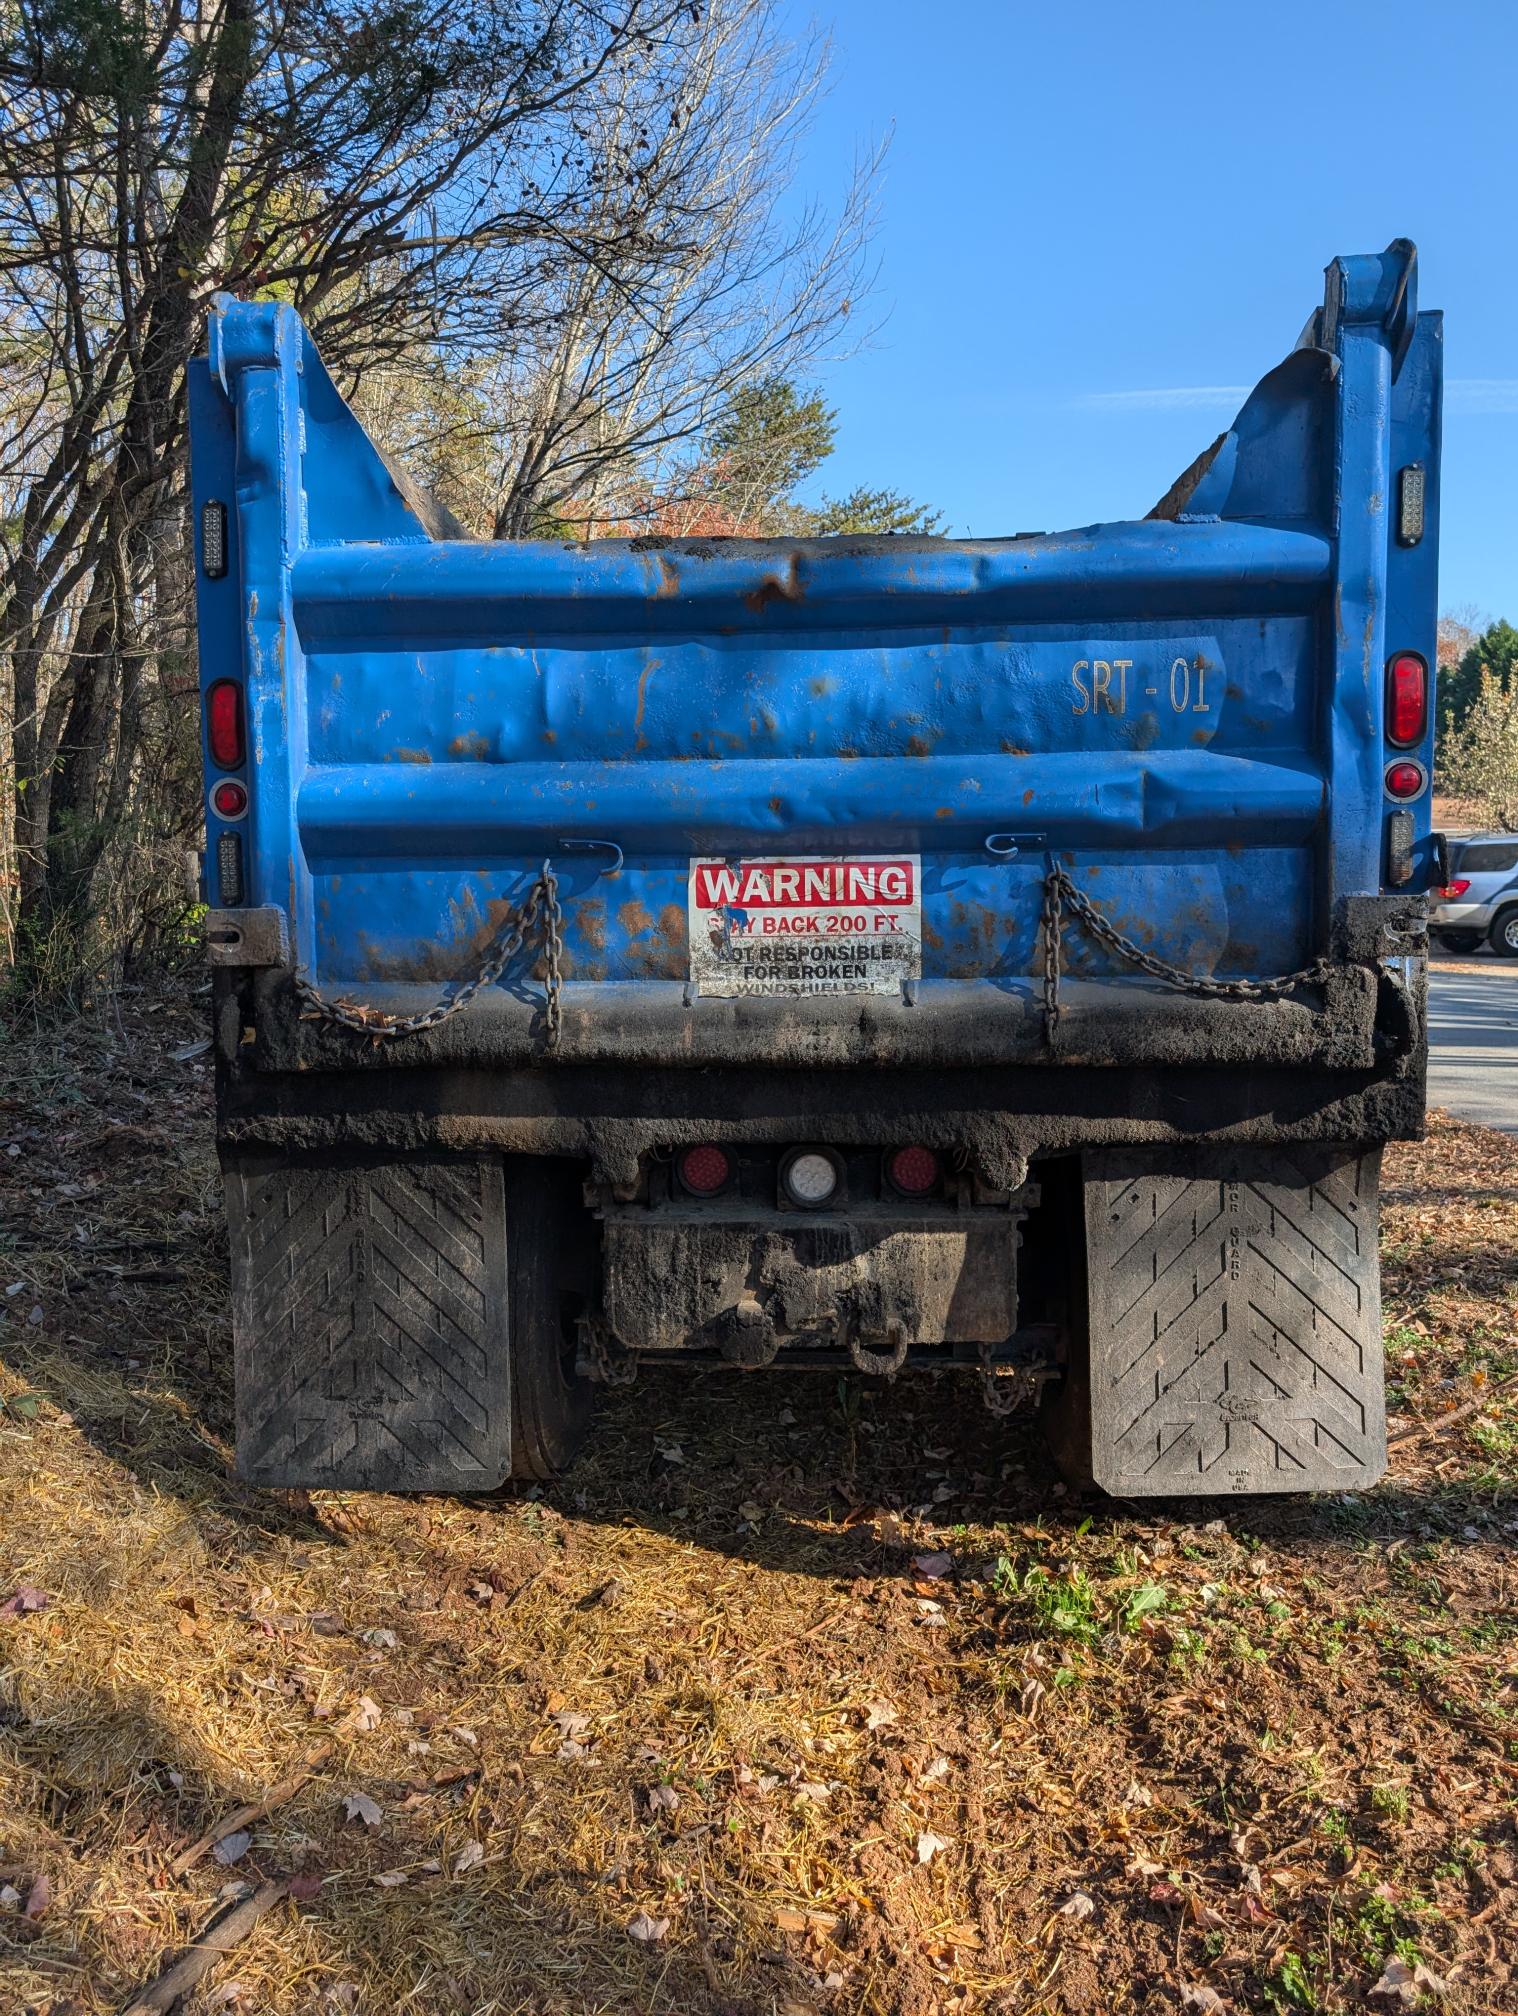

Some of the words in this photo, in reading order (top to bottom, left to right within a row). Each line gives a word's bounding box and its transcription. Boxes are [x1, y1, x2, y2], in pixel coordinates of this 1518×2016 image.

[1071, 659, 1133, 715] SRT
[1170, 657, 1210, 713] 01
[701, 866, 907, 903] WARNING
[762, 916, 819, 934] BACK
[826, 915, 867, 933] 200
[873, 914, 903, 932] FT.
[724, 946, 754, 962] OT
[759, 945, 893, 962] RESPONSIBLE
[743, 965, 781, 980] FOR
[788, 964, 867, 980] BROKEN
[736, 982, 875, 994] WINDSHIELDS!
